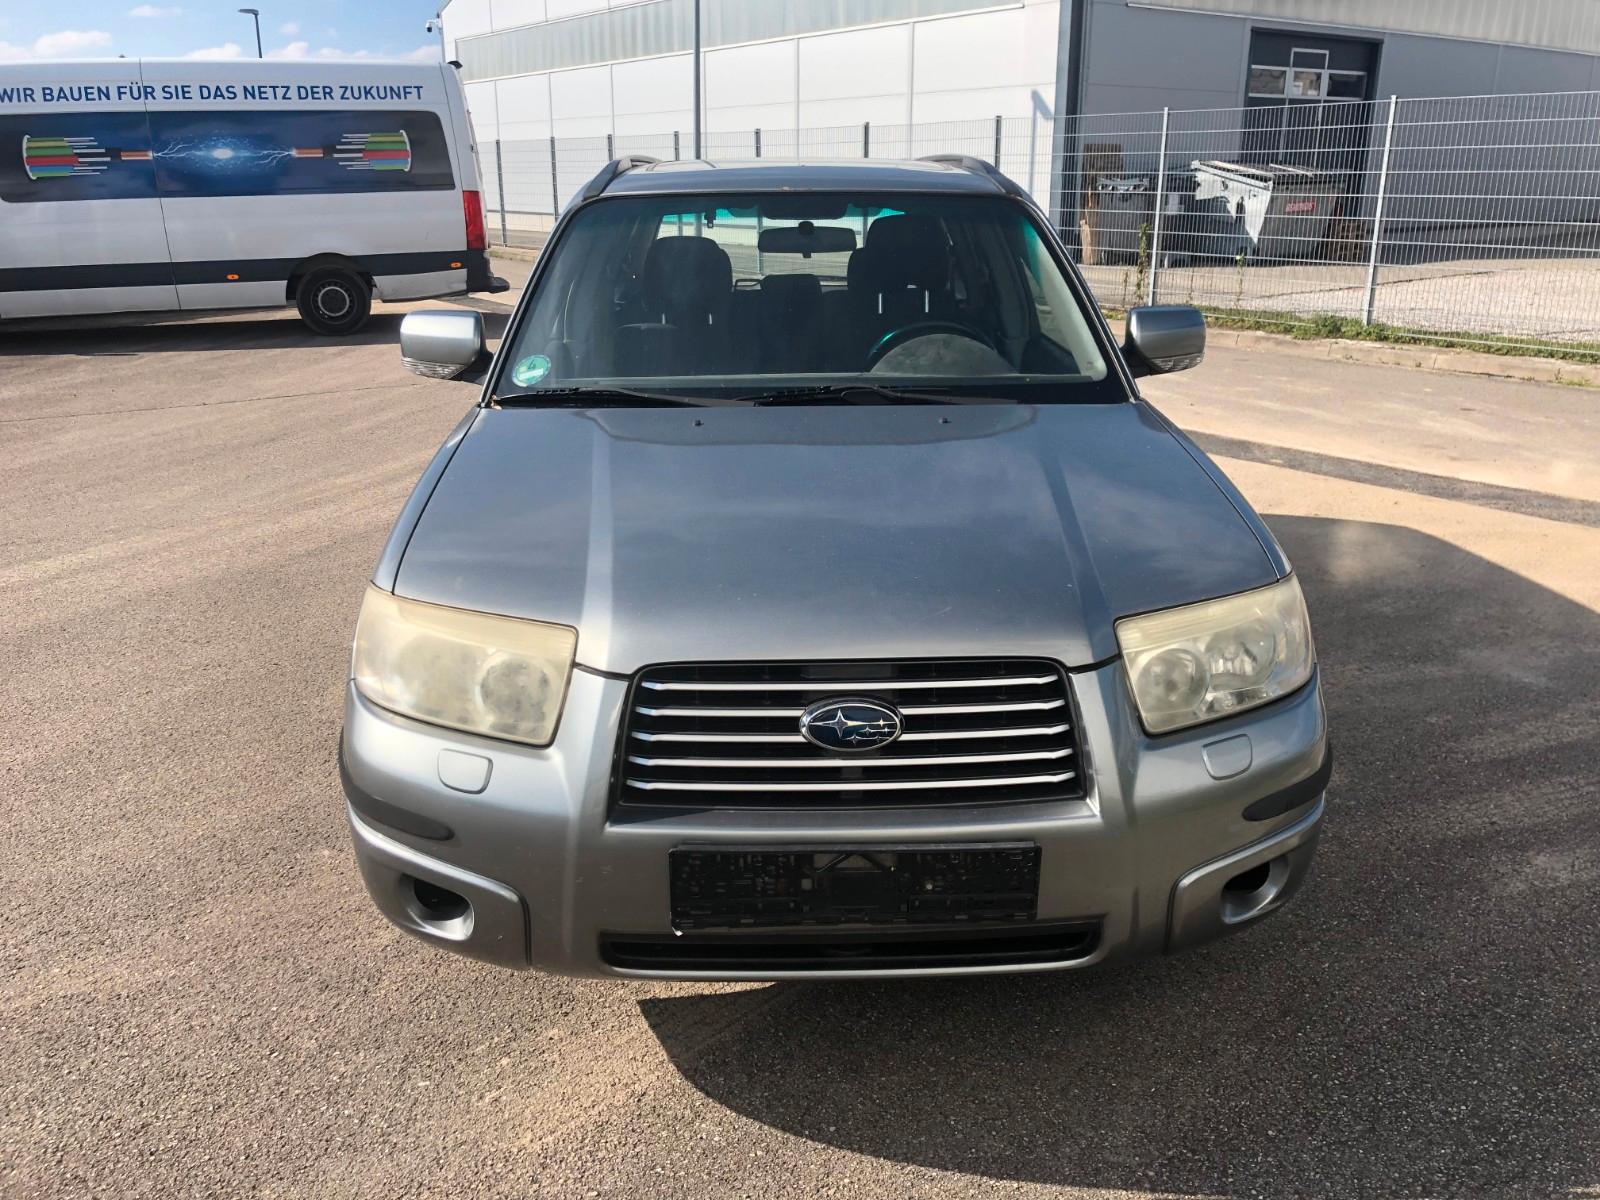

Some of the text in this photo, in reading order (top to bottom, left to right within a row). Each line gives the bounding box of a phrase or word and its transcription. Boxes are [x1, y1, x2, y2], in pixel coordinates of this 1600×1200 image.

[0, 82, 424, 103] WIR BAUEN FÜR SIE DAS NETZ DER ZUKUNFT
